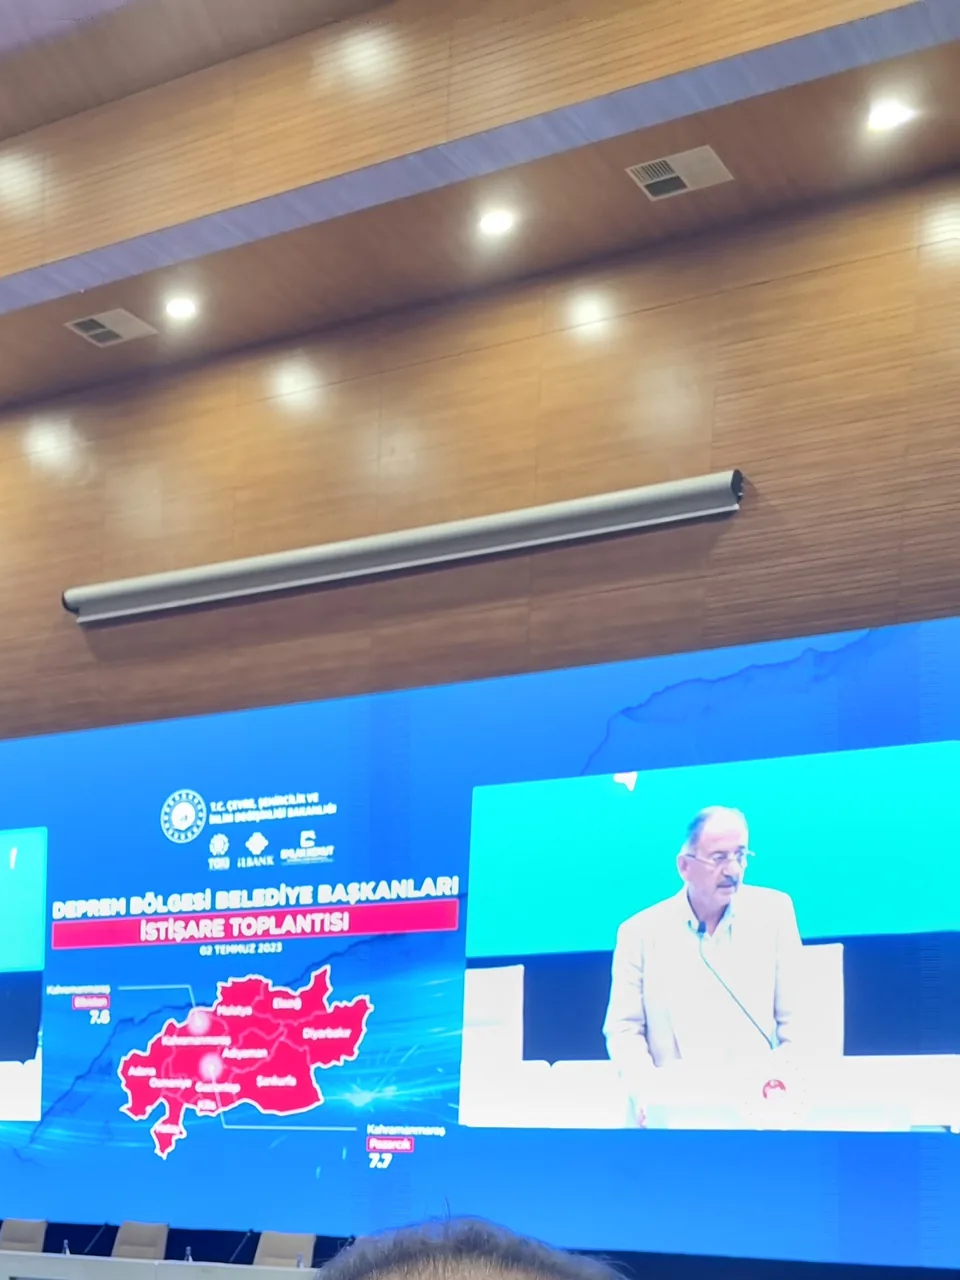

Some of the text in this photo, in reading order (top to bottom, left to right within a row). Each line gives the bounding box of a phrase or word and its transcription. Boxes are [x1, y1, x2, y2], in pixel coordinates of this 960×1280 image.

[52, 875, 459, 919] DEPREM BÖLGESİ BELEDİYE BAŞKANLARI
[140, 911, 350, 942] İSTİŞARE TOPLANTISI
[369, 1153, 393, 1169] 7.7
